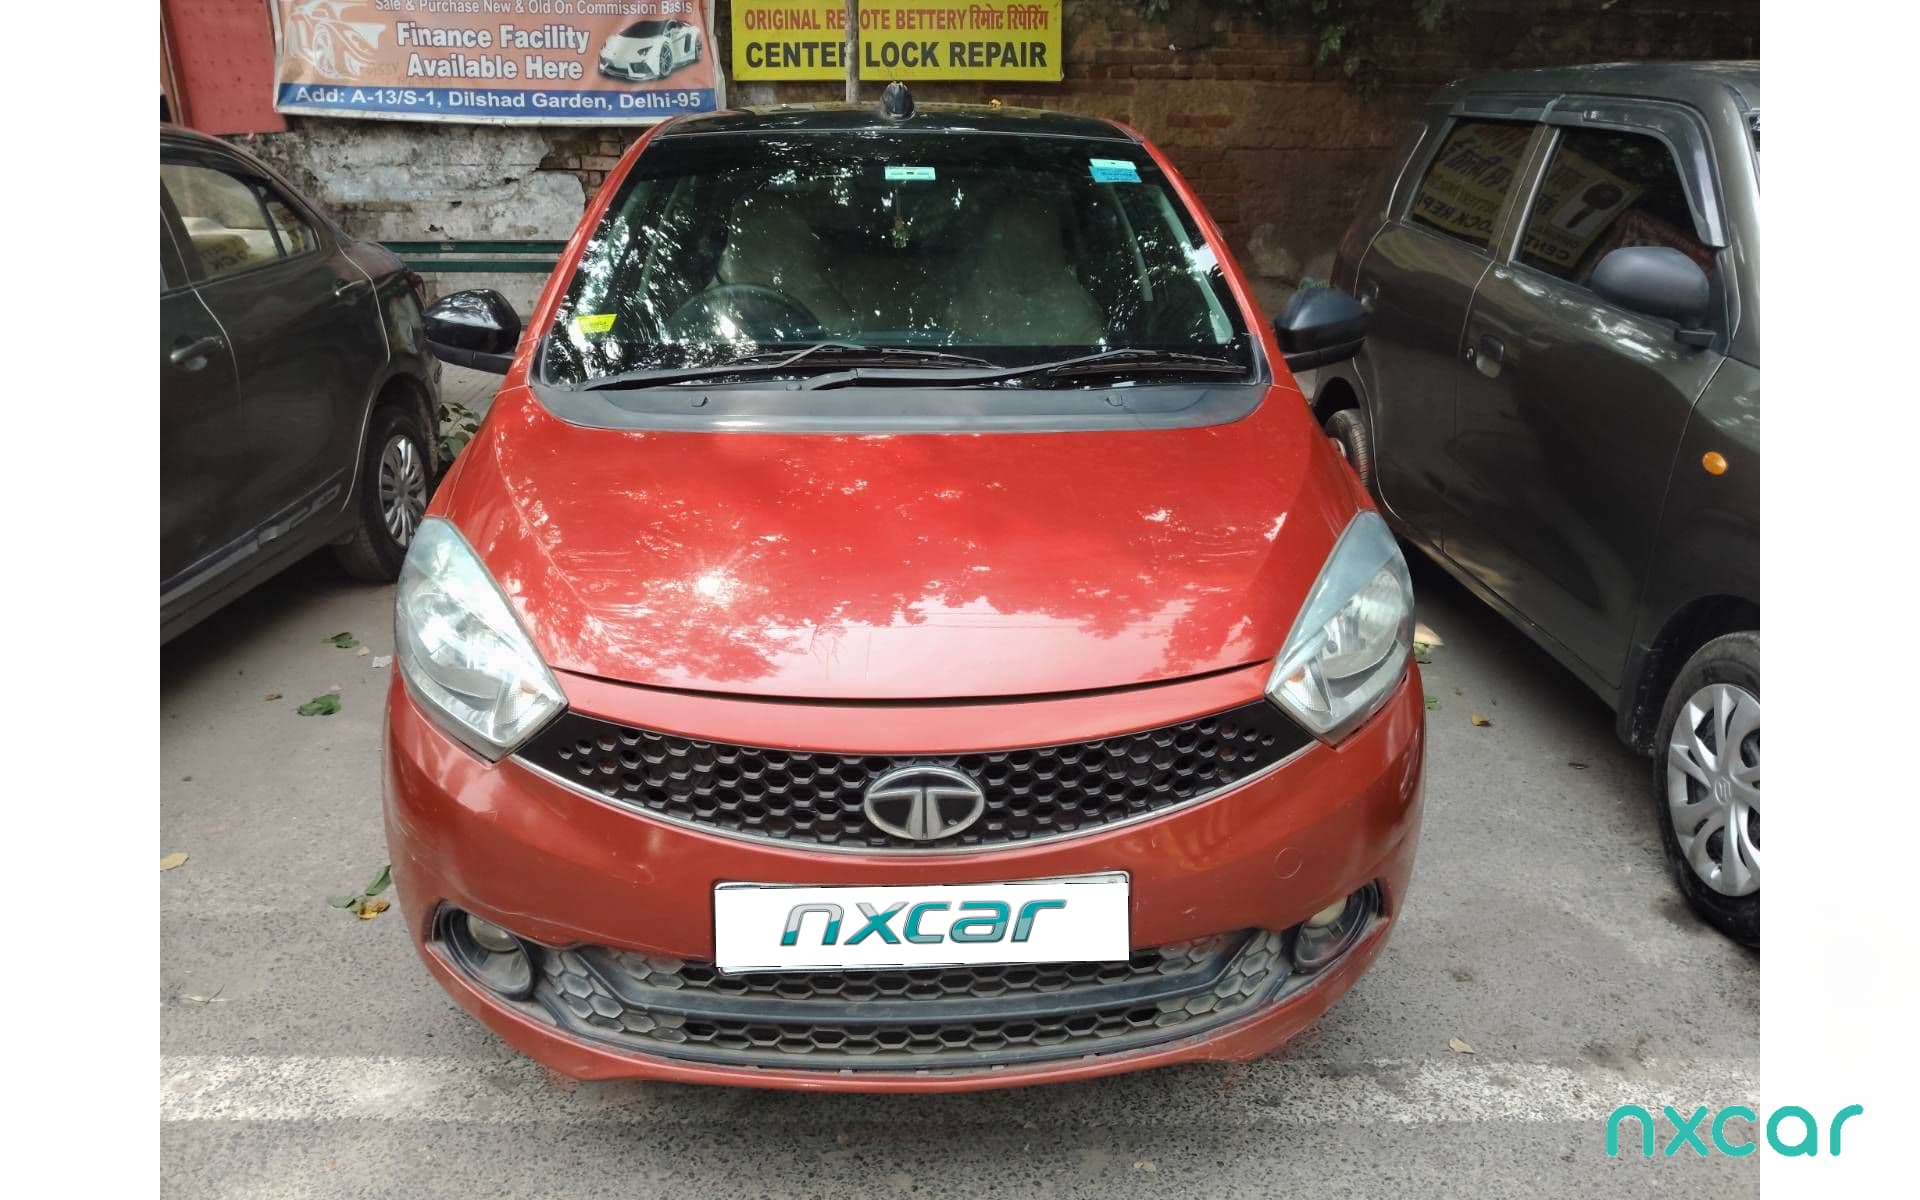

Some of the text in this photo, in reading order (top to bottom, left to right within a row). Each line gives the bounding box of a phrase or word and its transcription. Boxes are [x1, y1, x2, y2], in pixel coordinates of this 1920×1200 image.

[375, 0, 693, 15] Sale & Purchase New & Old On Commission Basis
[744, 9, 967, 30] ORIGINAL REOTE BETTERY
[969, 4, 1004, 30] रिमोट
[396, 21, 590, 55] Finance Facility
[407, 53, 518, 80] Available
[525, 55, 583, 80] Here
[865, 41, 940, 68] LOCK
[949, 41, 1047, 68] REPAIR
[296, 87, 700, 111] Add: A-13/S-1, Dilshad Garden, Delhi-95
